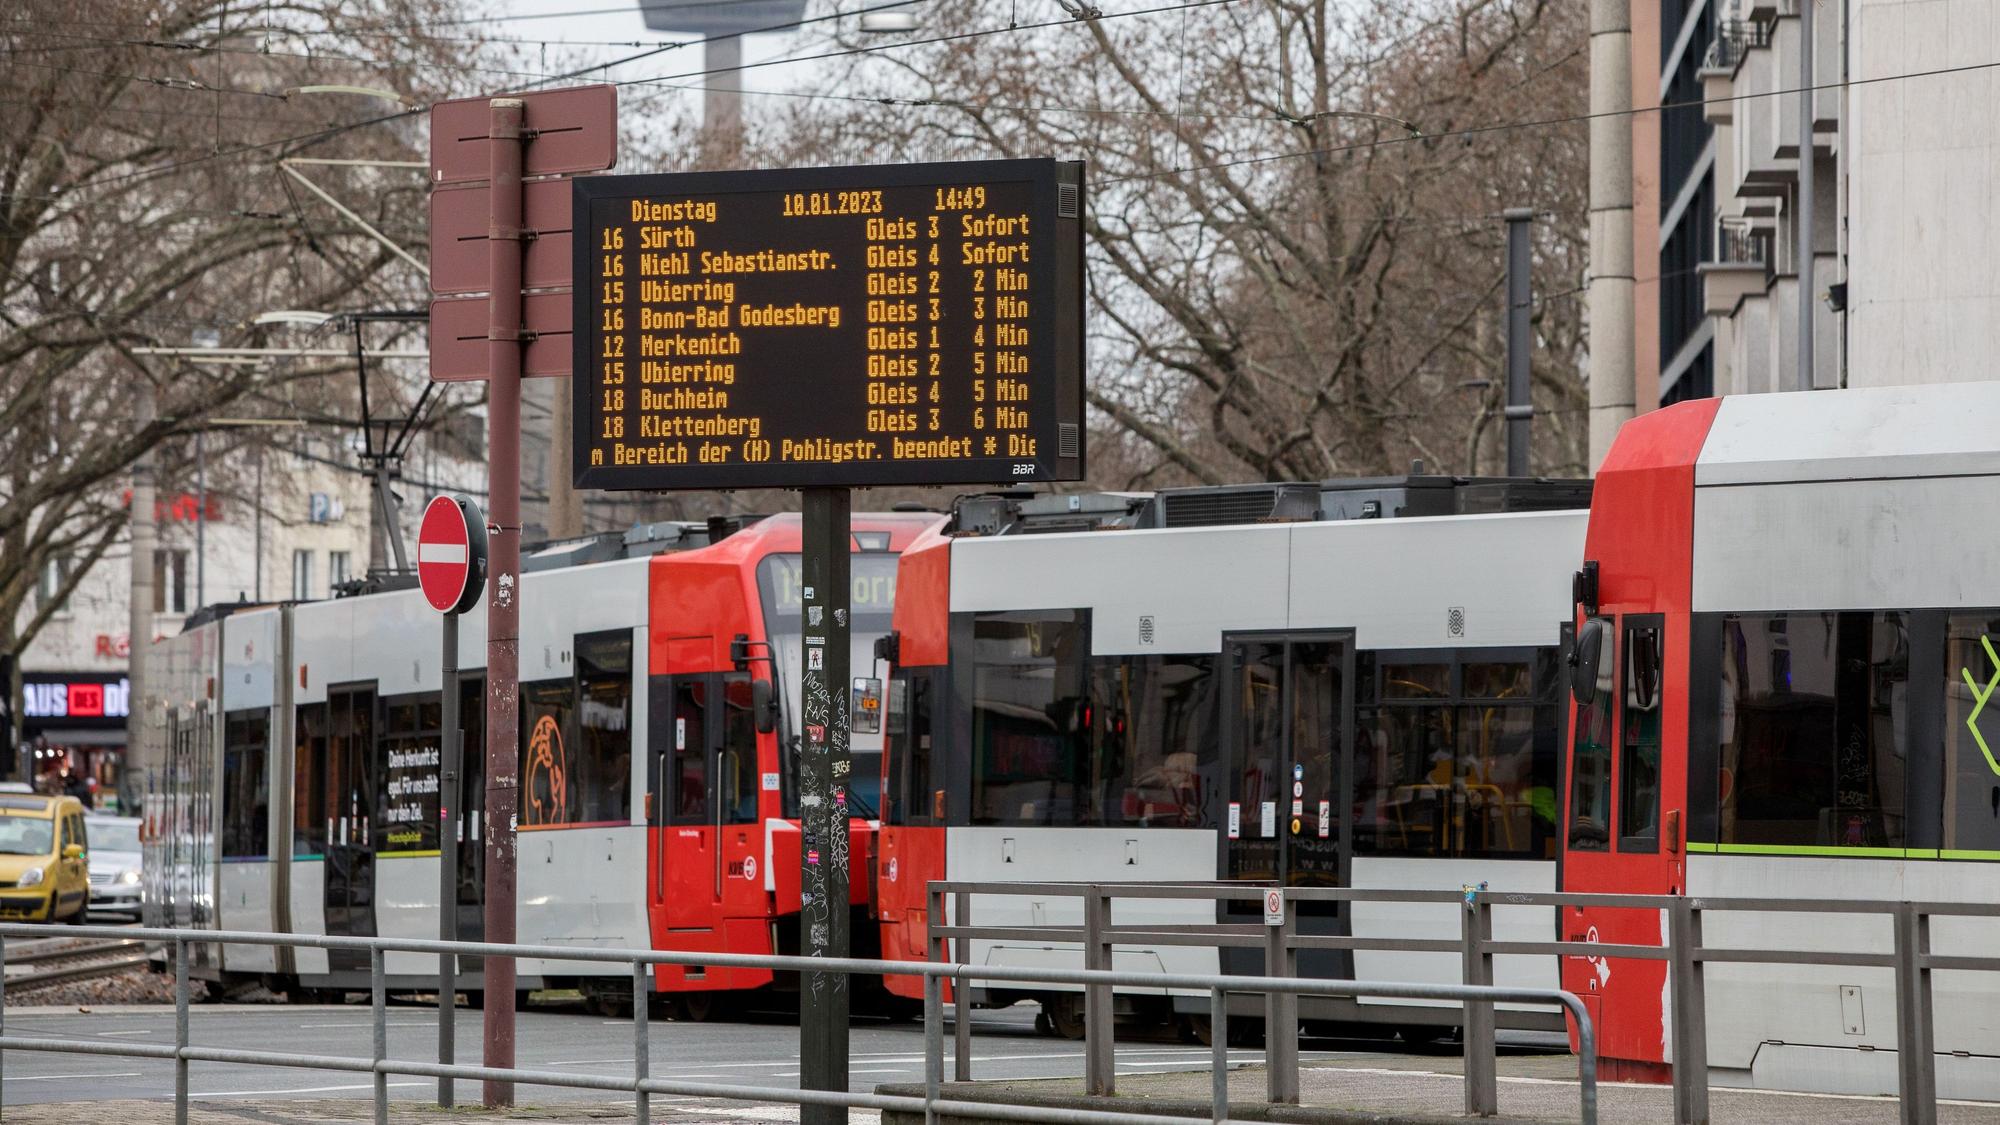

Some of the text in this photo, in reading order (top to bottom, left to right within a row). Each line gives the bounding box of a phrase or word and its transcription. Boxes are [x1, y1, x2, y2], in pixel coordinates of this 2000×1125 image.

[631, 186, 986, 223] Dienstag 10.01.2023 14:49
[602, 213, 1029, 250] 16 Sürth Gleis 3 Sofort
[602, 240, 1030, 277] 16 Niehl Sebastianstr. Gleis 4 Sofort
[602, 268, 1028, 304] 15 Ubierring Gleis 2 2 Min
[602, 295, 1029, 331] 16 Bonn-Bad Godesberg Gleis 3 3 Min
[602, 323, 1028, 358] 12 Merkenich Gleis 1 4 Min
[602, 351, 1028, 385] 15 Ubierring Gleis 2 5 Min
[602, 378, 1028, 412] 18 Buchheim Gleis 4 5 Min
[602, 406, 1028, 439] 18 Klettenberg Gleis 3 6 Min
[591, 448, 603, 466] m
[614, 441, 688, 465] Bereich
[698, 440, 732, 463] der
[742, 440, 771, 462] (H)
[781, 438, 882, 464] Pohligstr.
[893, 435, 972, 459] beendet
[1012, 463, 1036, 475] BBR
